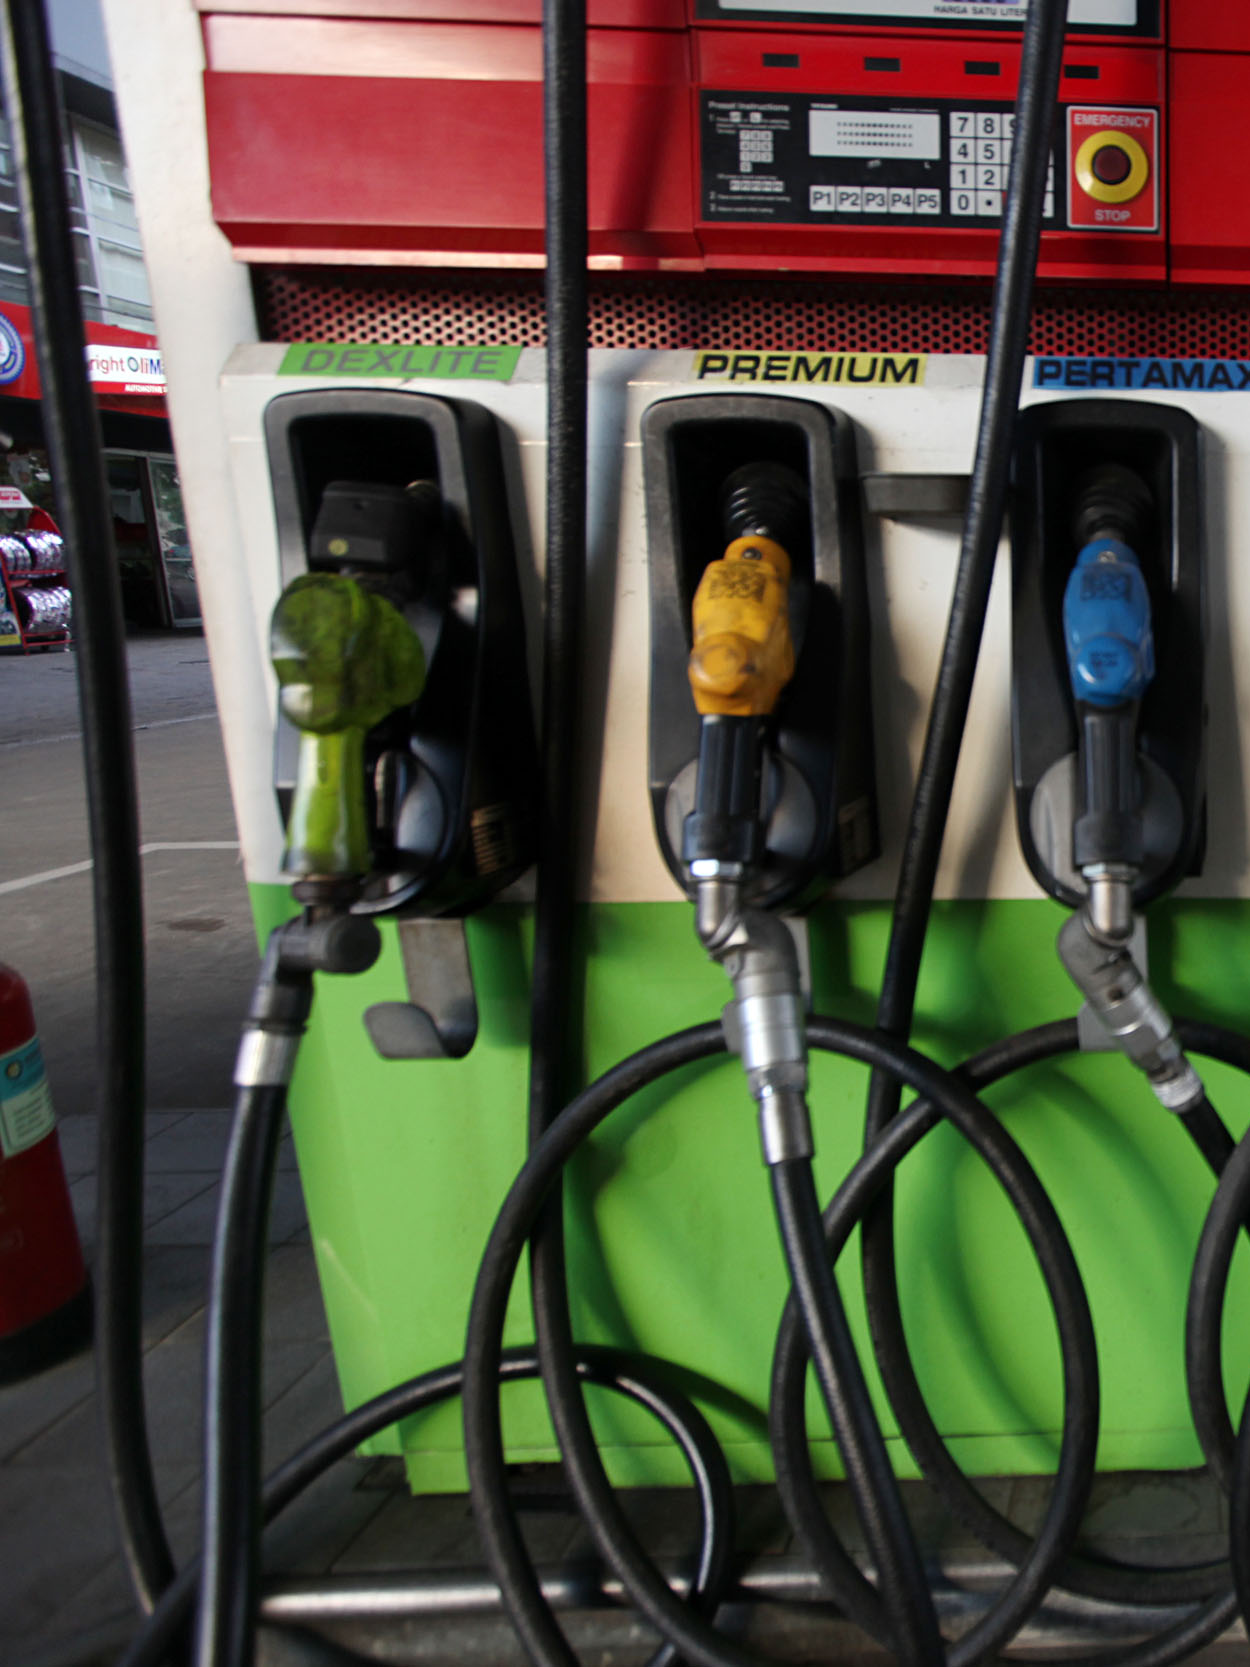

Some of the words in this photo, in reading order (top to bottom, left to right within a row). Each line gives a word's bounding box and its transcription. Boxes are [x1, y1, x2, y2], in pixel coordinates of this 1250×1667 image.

[933, 5, 968, 14] HARGA
[972, 6, 997, 16] SATU
[957, 116, 968, 132] 7
[983, 117, 994, 134] 8
[1073, 112, 1151, 127] EMERGENCY
[957, 142, 968, 158] 4
[983, 143, 995, 159] 5
[958, 168, 967, 184] 1
[983, 169, 995, 185] 2
[813, 191, 831, 205] P1
[838, 191, 860, 206] P2
[864, 192, 886, 207] P3
[890, 193, 912, 208] P4
[917, 194, 938, 209] P5
[1094, 209, 1132, 222] STOP
[87, 354, 126, 375] right
[127, 356, 167, 375] OliM
[302, 348, 504, 374] DEXLITE
[697, 353, 920, 384] PREMIUM
